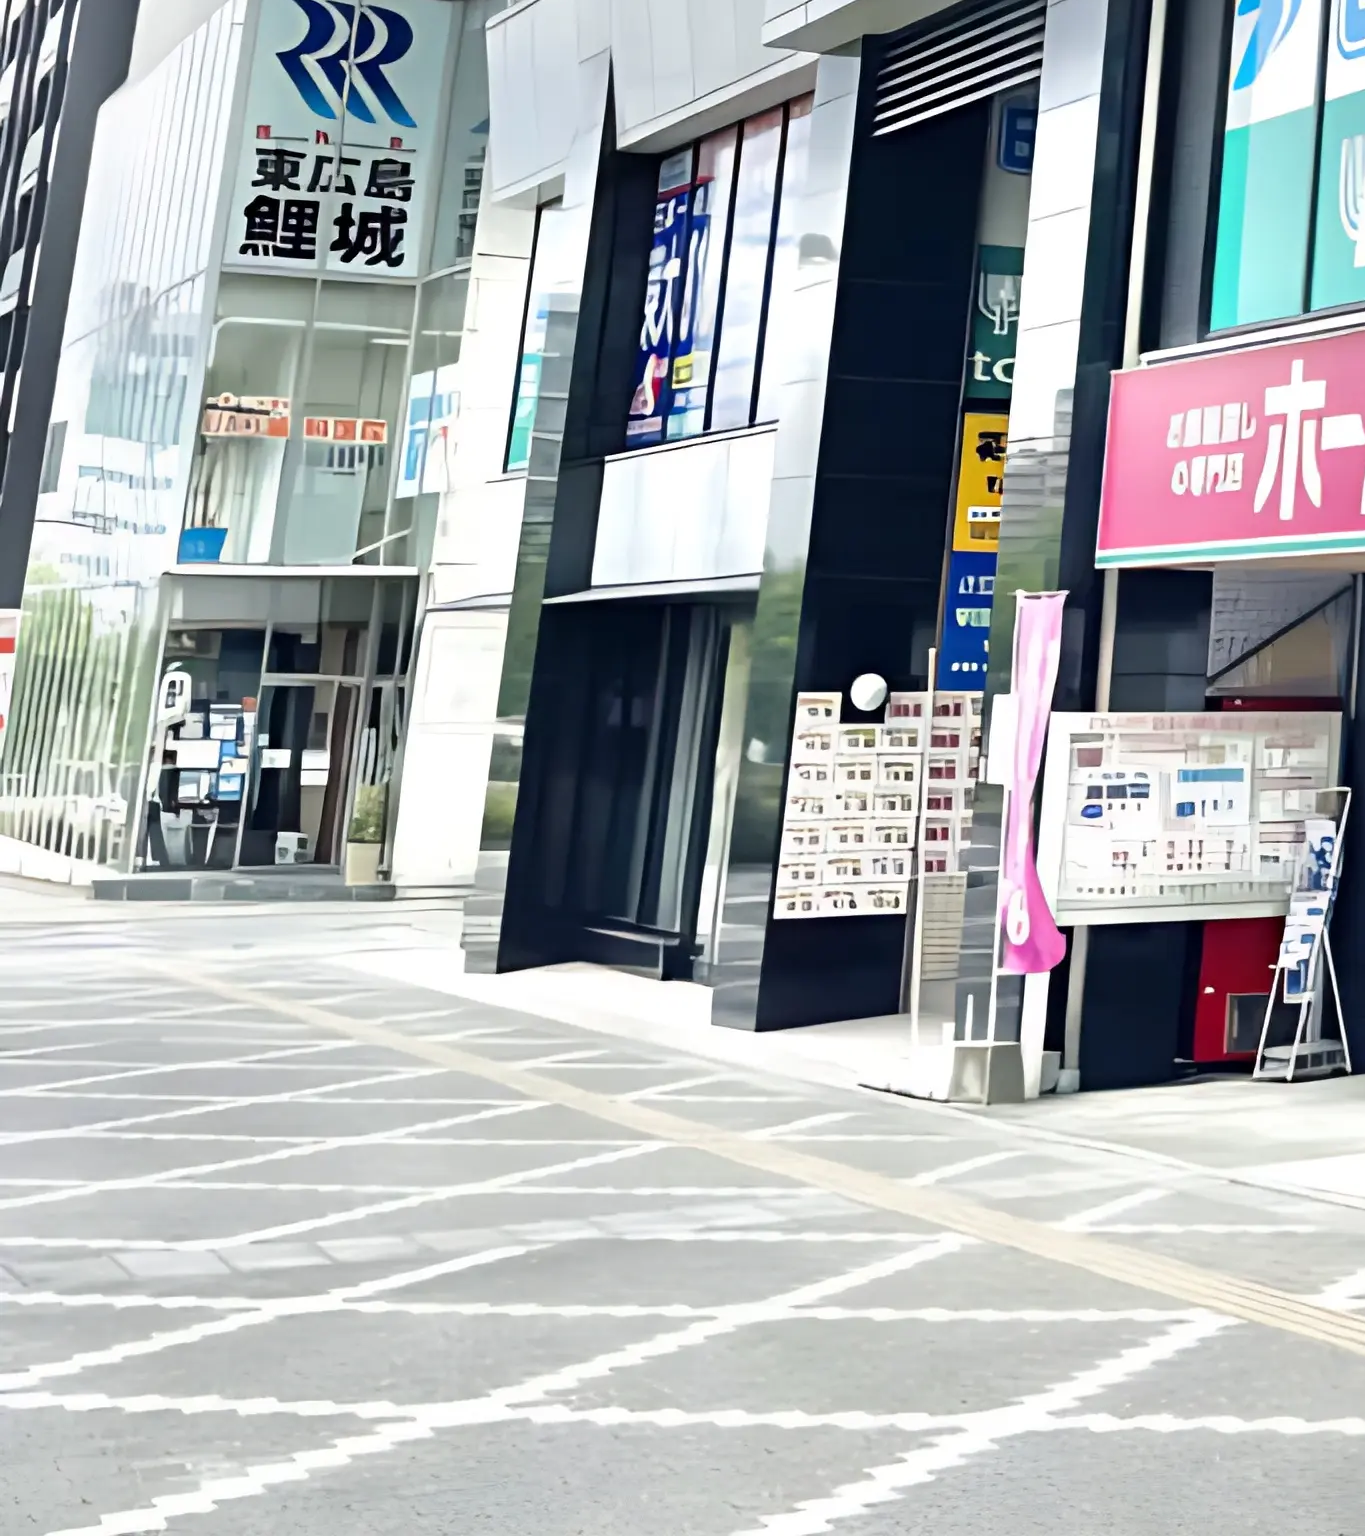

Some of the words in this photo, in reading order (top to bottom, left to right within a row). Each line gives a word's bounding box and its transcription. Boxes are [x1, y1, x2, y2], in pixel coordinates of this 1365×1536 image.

[251, 147, 416, 203] 東広島
[239, 194, 408, 268] 鯉城
